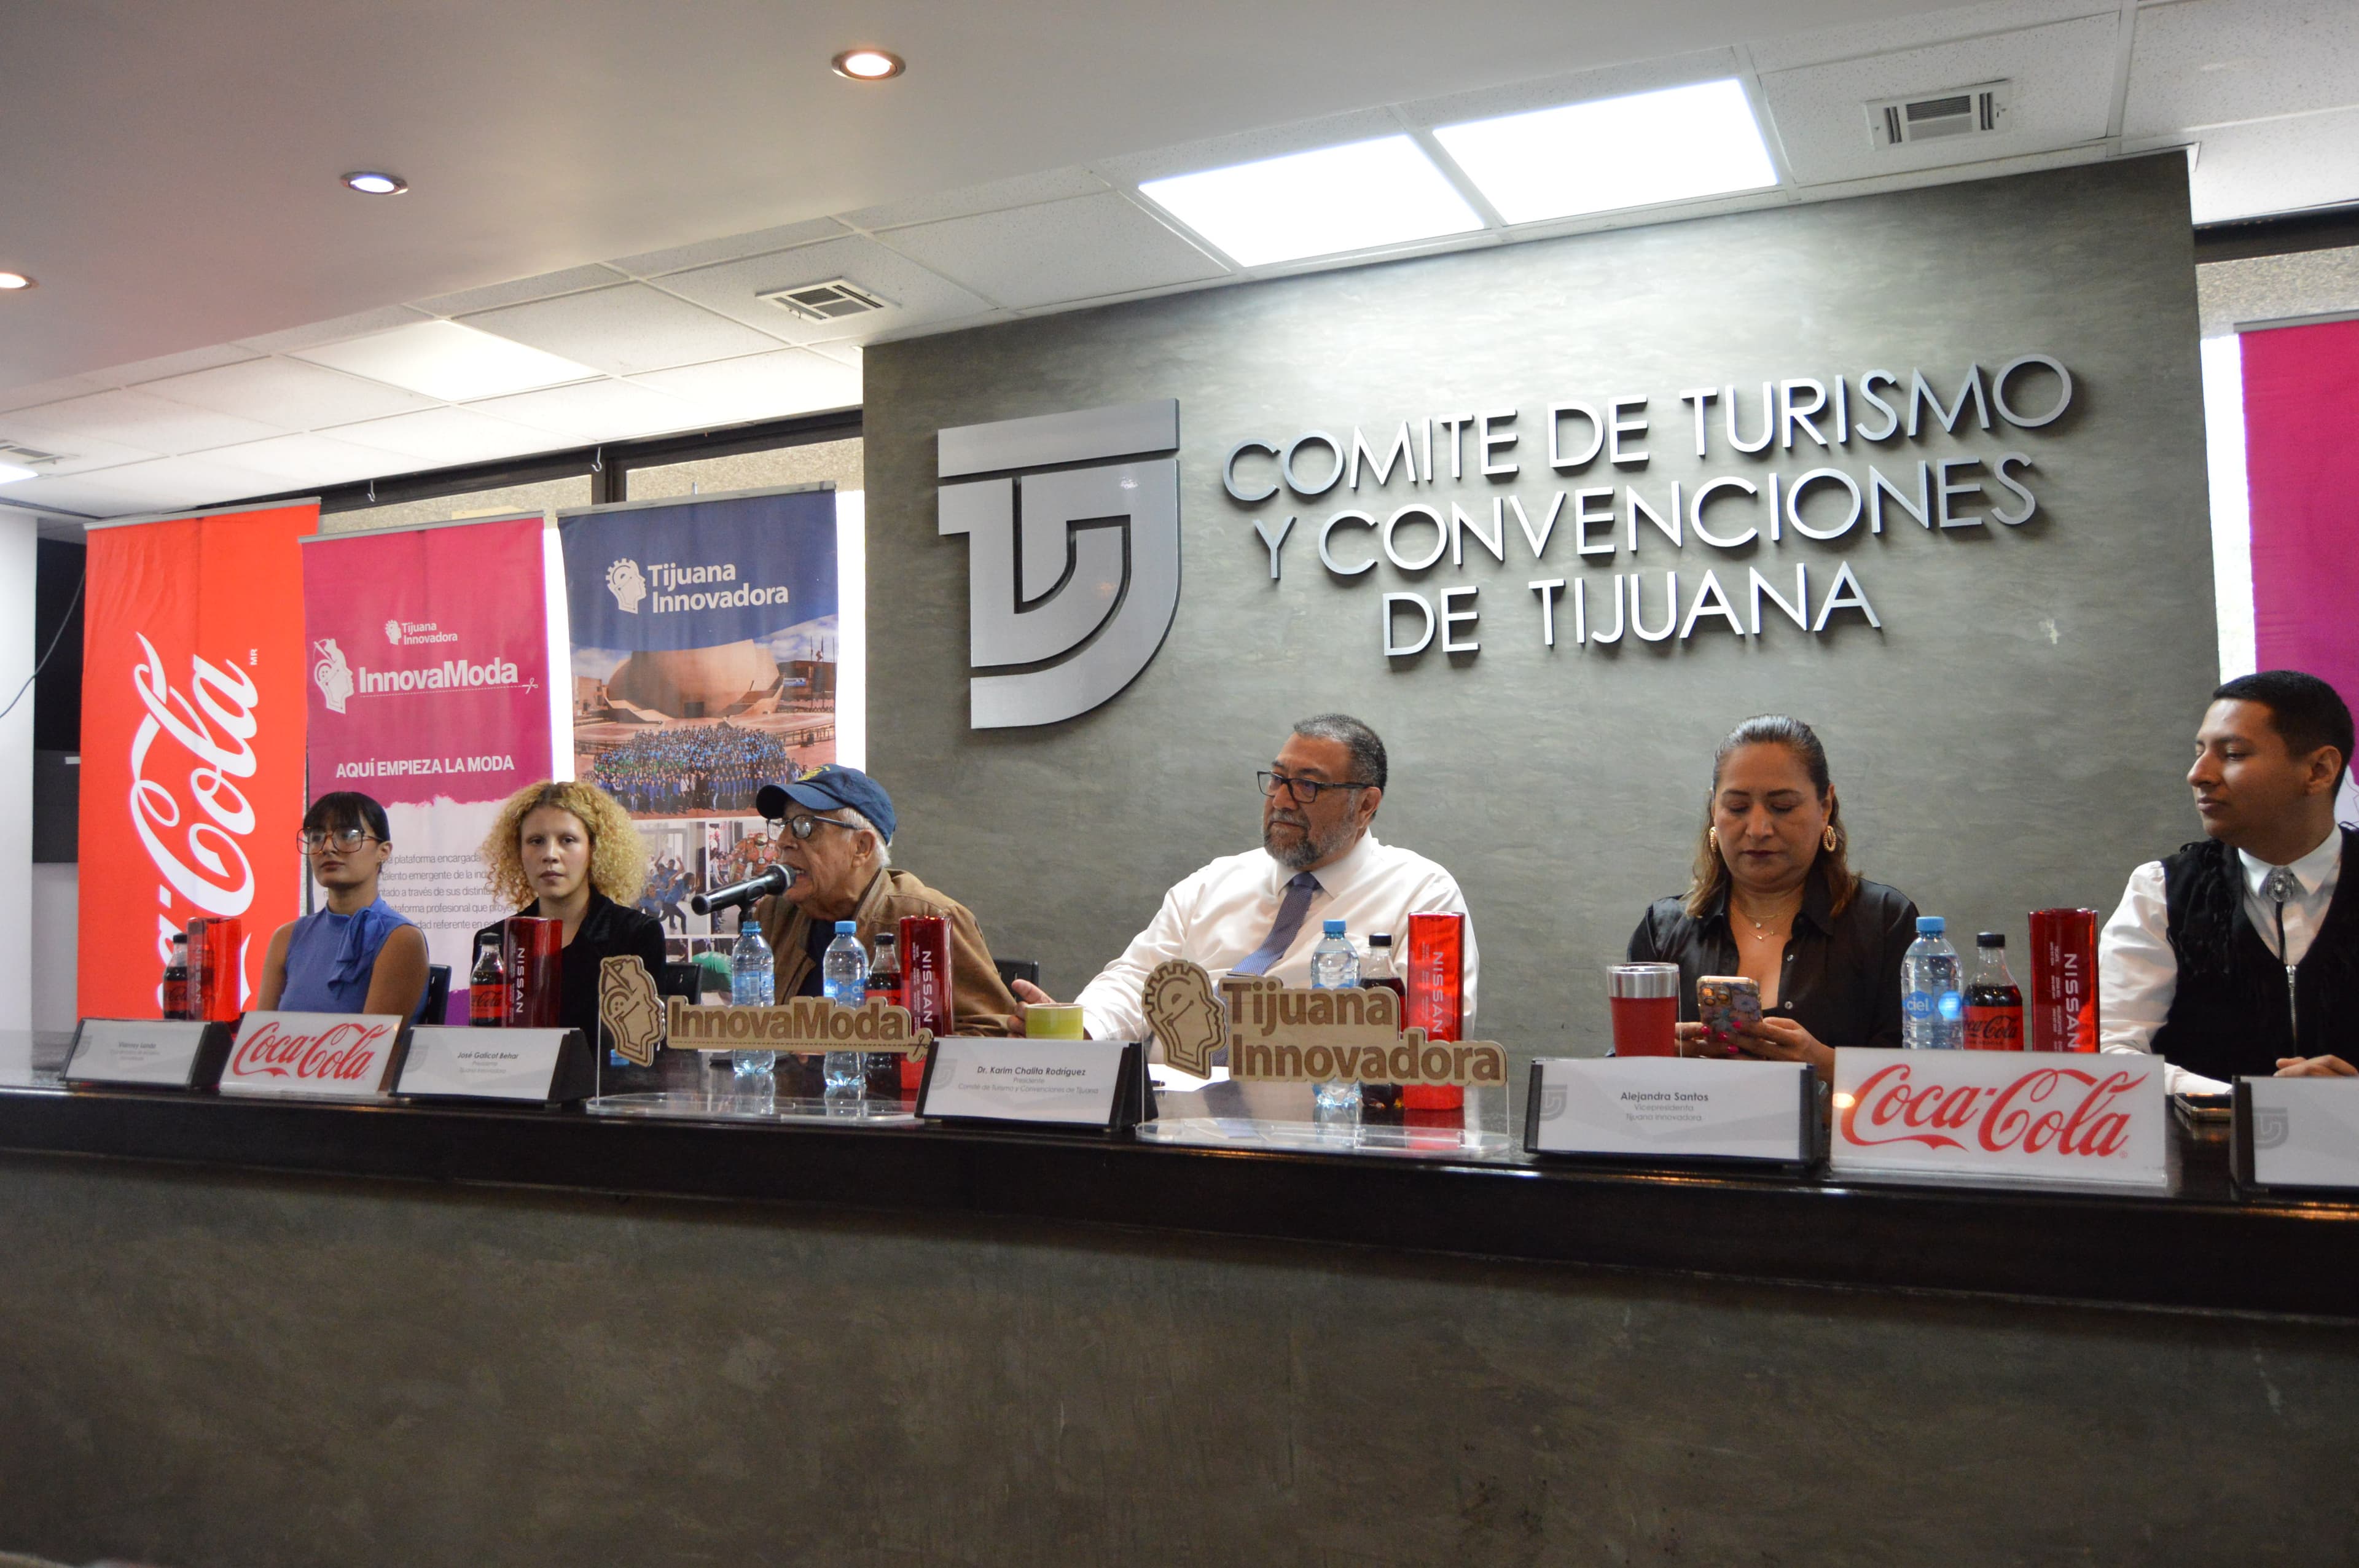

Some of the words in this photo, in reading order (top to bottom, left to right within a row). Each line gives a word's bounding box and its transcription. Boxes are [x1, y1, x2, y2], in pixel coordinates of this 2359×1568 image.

[1223, 408, 1519, 501] COMITE
[1548, 394, 1650, 469] DE
[1679, 353, 2072, 456] TURISMO
[1253, 516, 1297, 579] Y
[1318, 451, 2036, 575] CONVENCIONES
[647, 563, 736, 591] Tijuana
[652, 583, 789, 614] Innovadora
[1383, 586, 1480, 656] DE
[1528, 561, 1882, 646] TIJUANA
[402, 622, 437, 635] Tijuana
[404, 632, 458, 645] Innovadora
[249, 649, 258, 666] MR
[359, 657, 518, 693] InnovaModa
[336, 758, 374, 778] AQUÍ
[377, 759, 442, 776] EMPIEZA
[445, 757, 465, 774] LA
[467, 755, 515, 773] MODA
[394, 854, 436, 865] plataforma
[437, 852, 481, 864] encargada
[383, 872, 407, 880] talento
[409, 871, 452, 881] emergente
[453, 870, 464, 879] de
[466, 870, 472, 879] la
[409, 886, 432, 896] través
[434, 886, 444, 895] de
[426, 902, 471, 914] profesional
[472, 903, 488, 913] que
[433, 919, 471, 929] referente
[516, 948, 526, 1013] NISSAN
[922, 951, 933, 1022] NISSAN
[1433, 951, 1444, 1033] NISSAN
[1223, 981, 1394, 1037] Tijuana
[1906, 996, 1930, 1012] ciel
[2064, 953, 2081, 1048] NISSAN
[671, 1000, 906, 1040] InnovaModa
[233, 1021, 393, 1080] Coca-Cola
[1232, 1034, 1501, 1081] Innovadora
[1015, 1066, 1043, 1075] Chalita
[1046, 1067, 1086, 1078] Rodríguez
[1621, 1091, 1671, 1102] Alejandra
[1674, 1092, 1709, 1101] Santos
[1840, 1063, 2150, 1158] Coca-Cola
